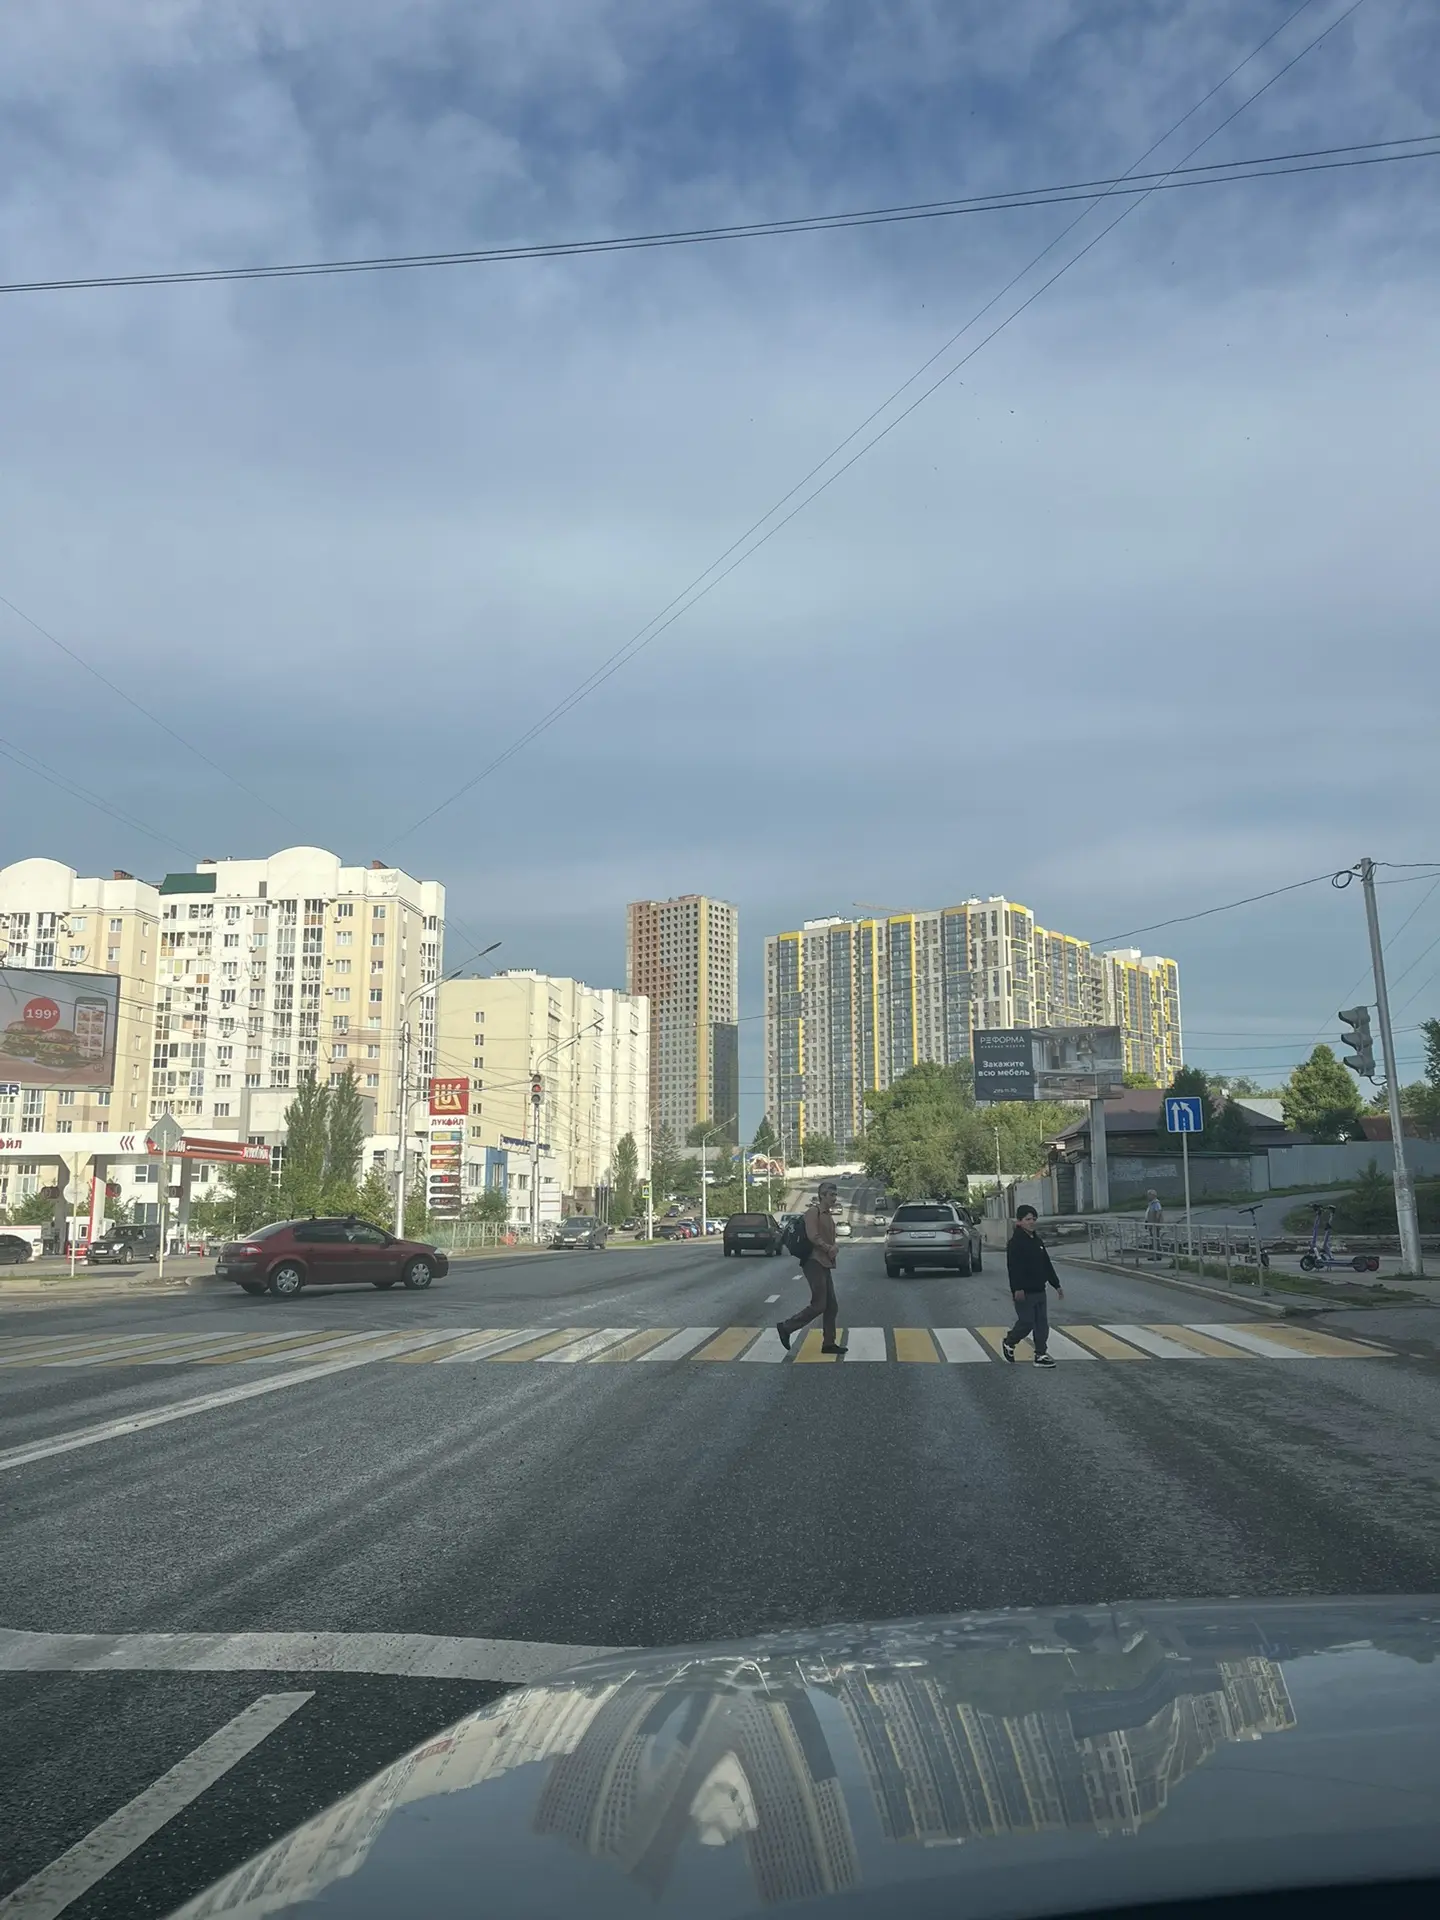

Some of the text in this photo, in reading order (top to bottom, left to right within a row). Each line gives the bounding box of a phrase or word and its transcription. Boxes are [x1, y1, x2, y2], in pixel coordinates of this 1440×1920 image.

[980, 1036, 1025, 1044] РЕФОРМА
[982, 1060, 1025, 1068] Закажите
[431, 1117, 464, 1126] ЛУКОЙЛ
